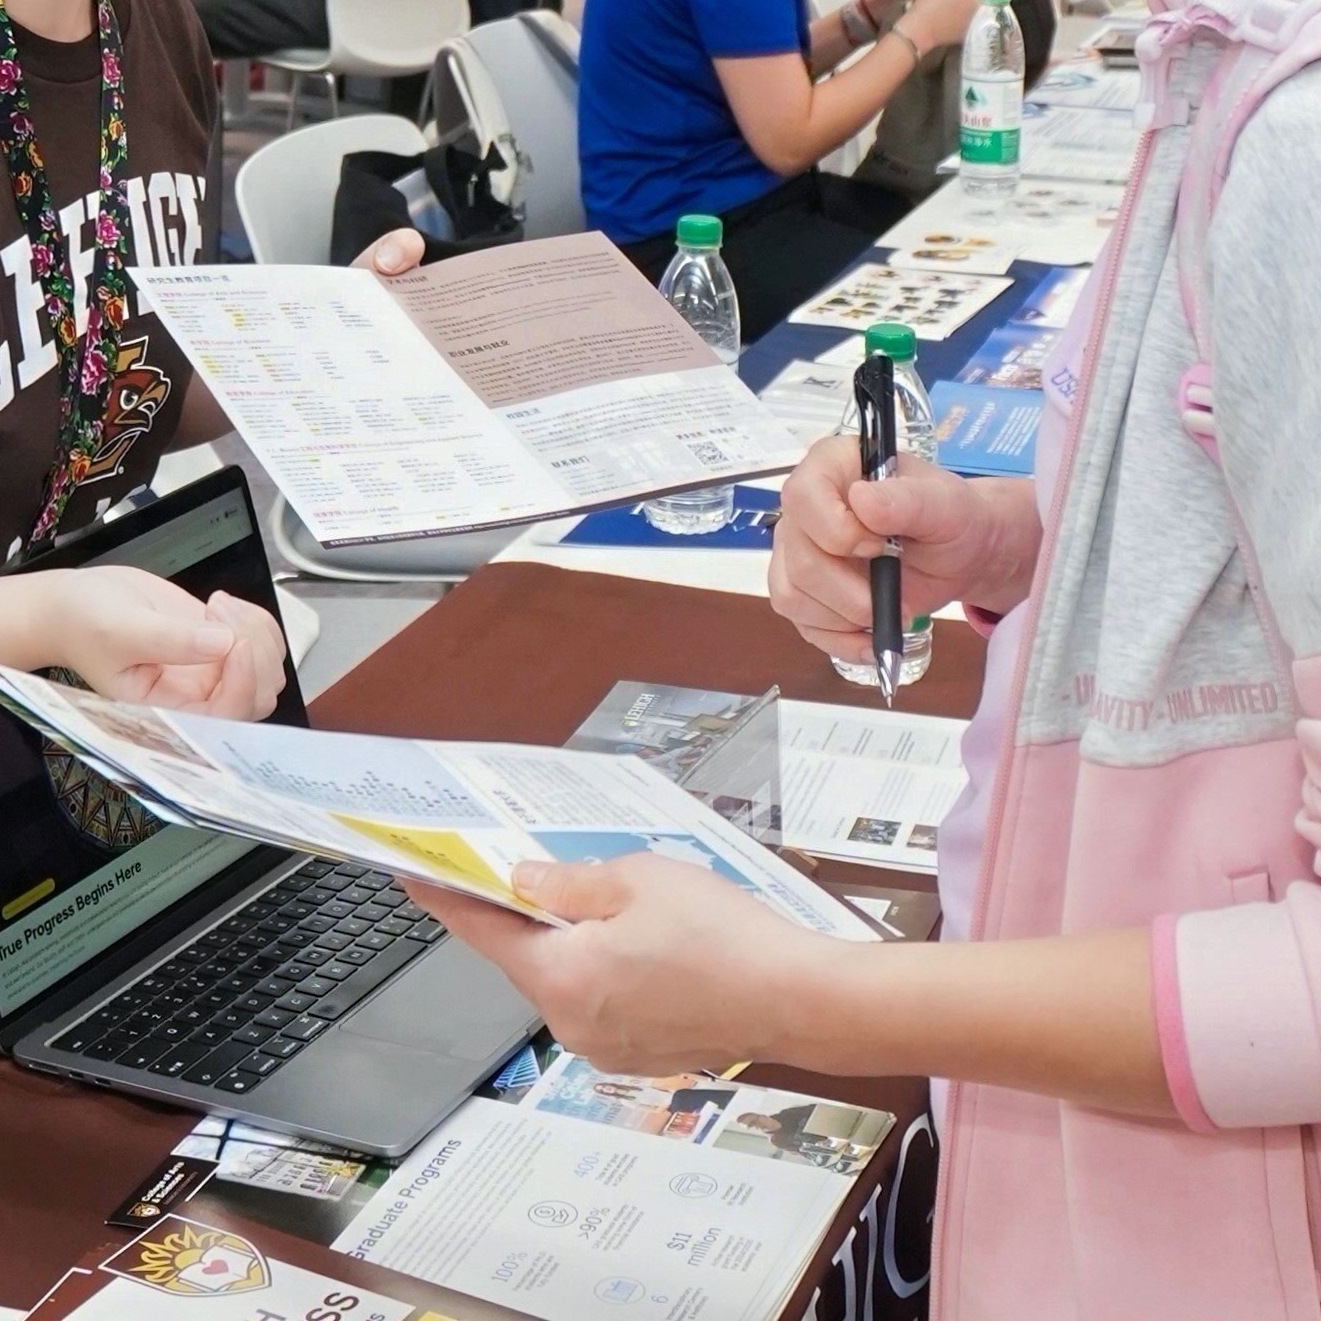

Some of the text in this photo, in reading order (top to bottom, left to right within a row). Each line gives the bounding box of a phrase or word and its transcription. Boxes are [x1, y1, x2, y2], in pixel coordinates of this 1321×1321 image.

[24, 902, 75, 946] Progress
[76, 878, 116, 912] Begins
[115, 859, 143, 886] Here
[346, 1138, 462, 1261] Graduate Programs
[666, 1231, 693, 1252] $11
[687, 1227, 722, 1267] million
[491, 1251, 528, 1284] 100%
